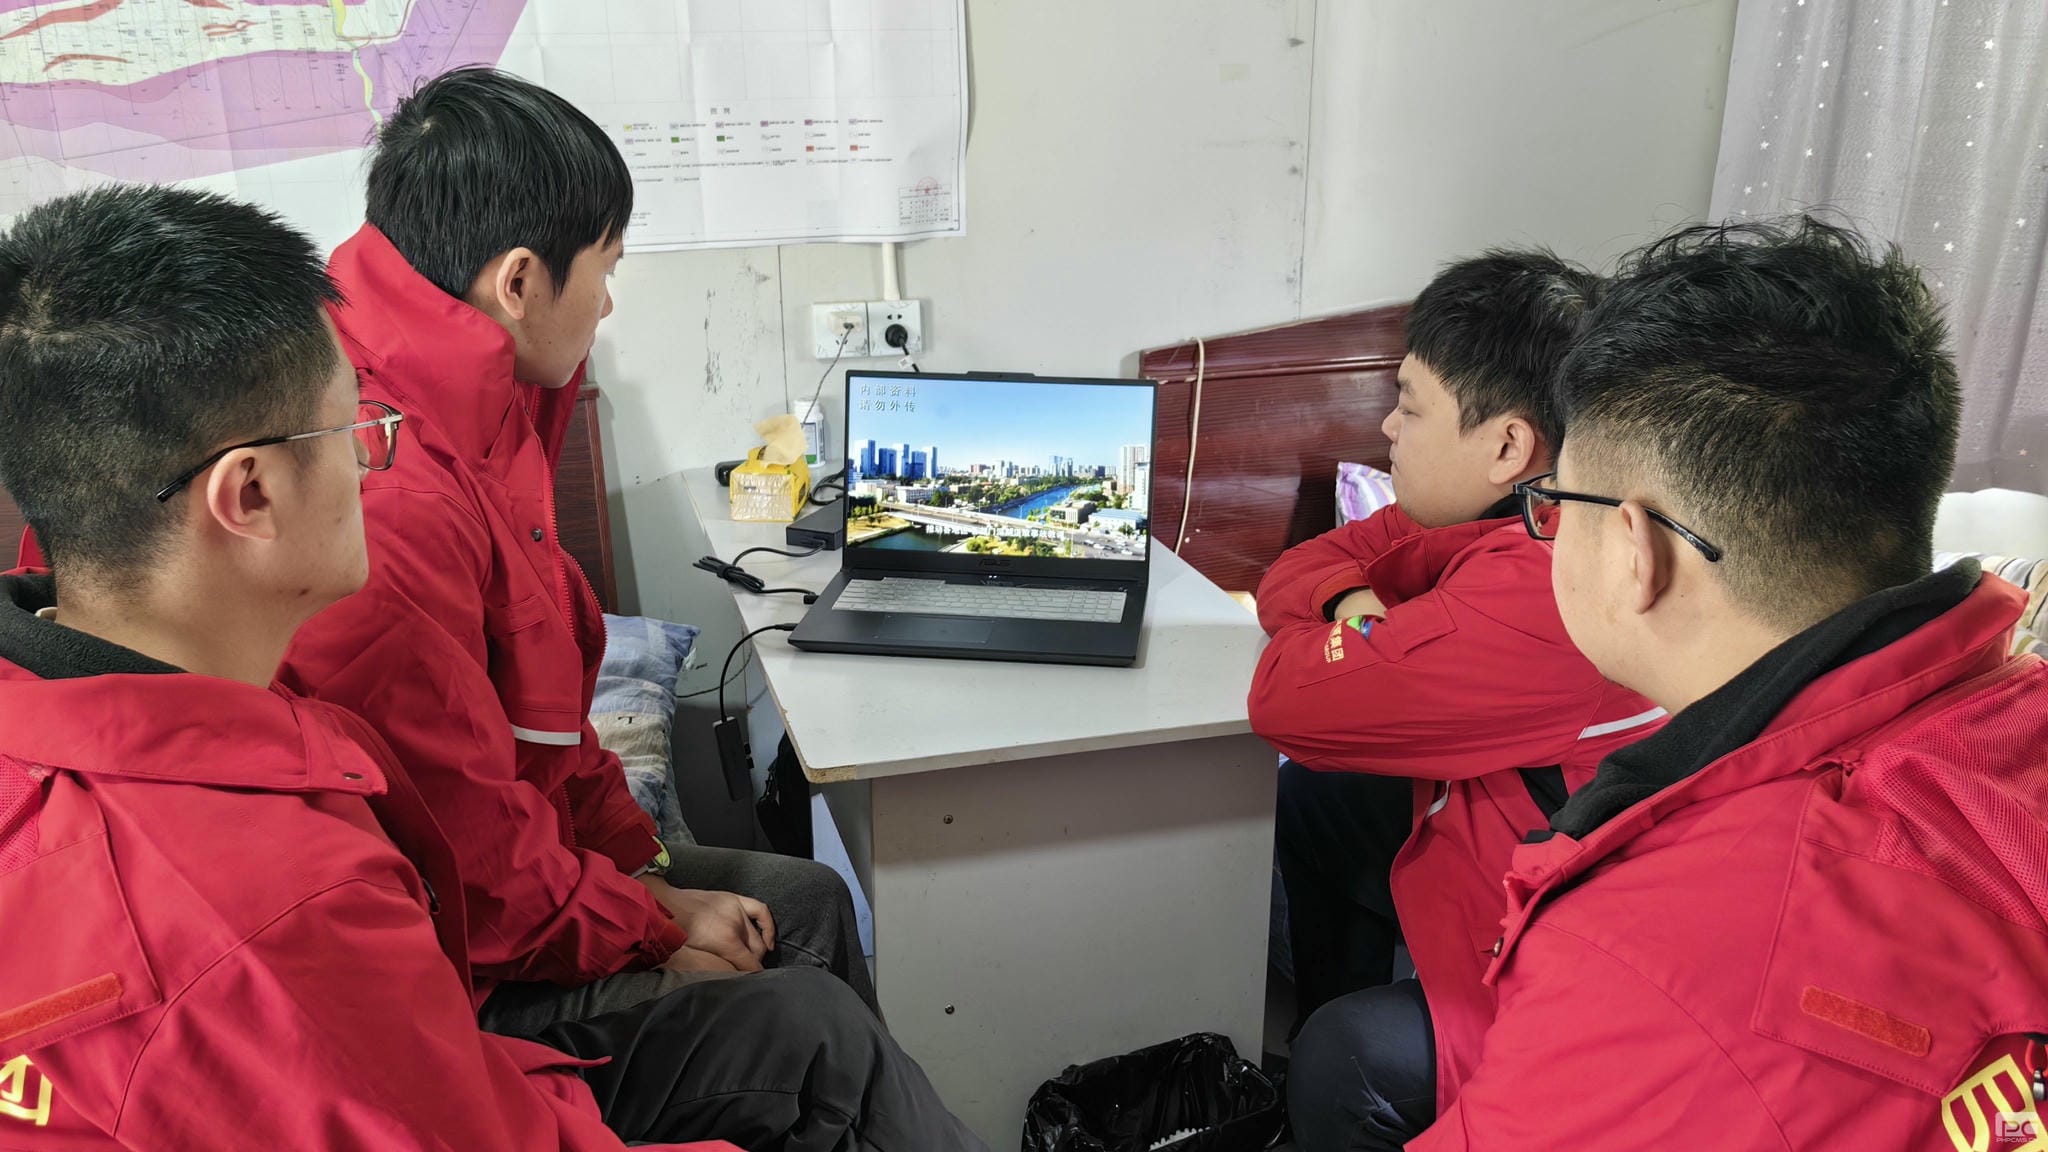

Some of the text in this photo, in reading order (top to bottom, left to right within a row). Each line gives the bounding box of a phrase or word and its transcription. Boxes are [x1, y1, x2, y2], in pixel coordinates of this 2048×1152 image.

[860, 384, 917, 397] 内部资料
[859, 399, 917, 412] 请勿外传
